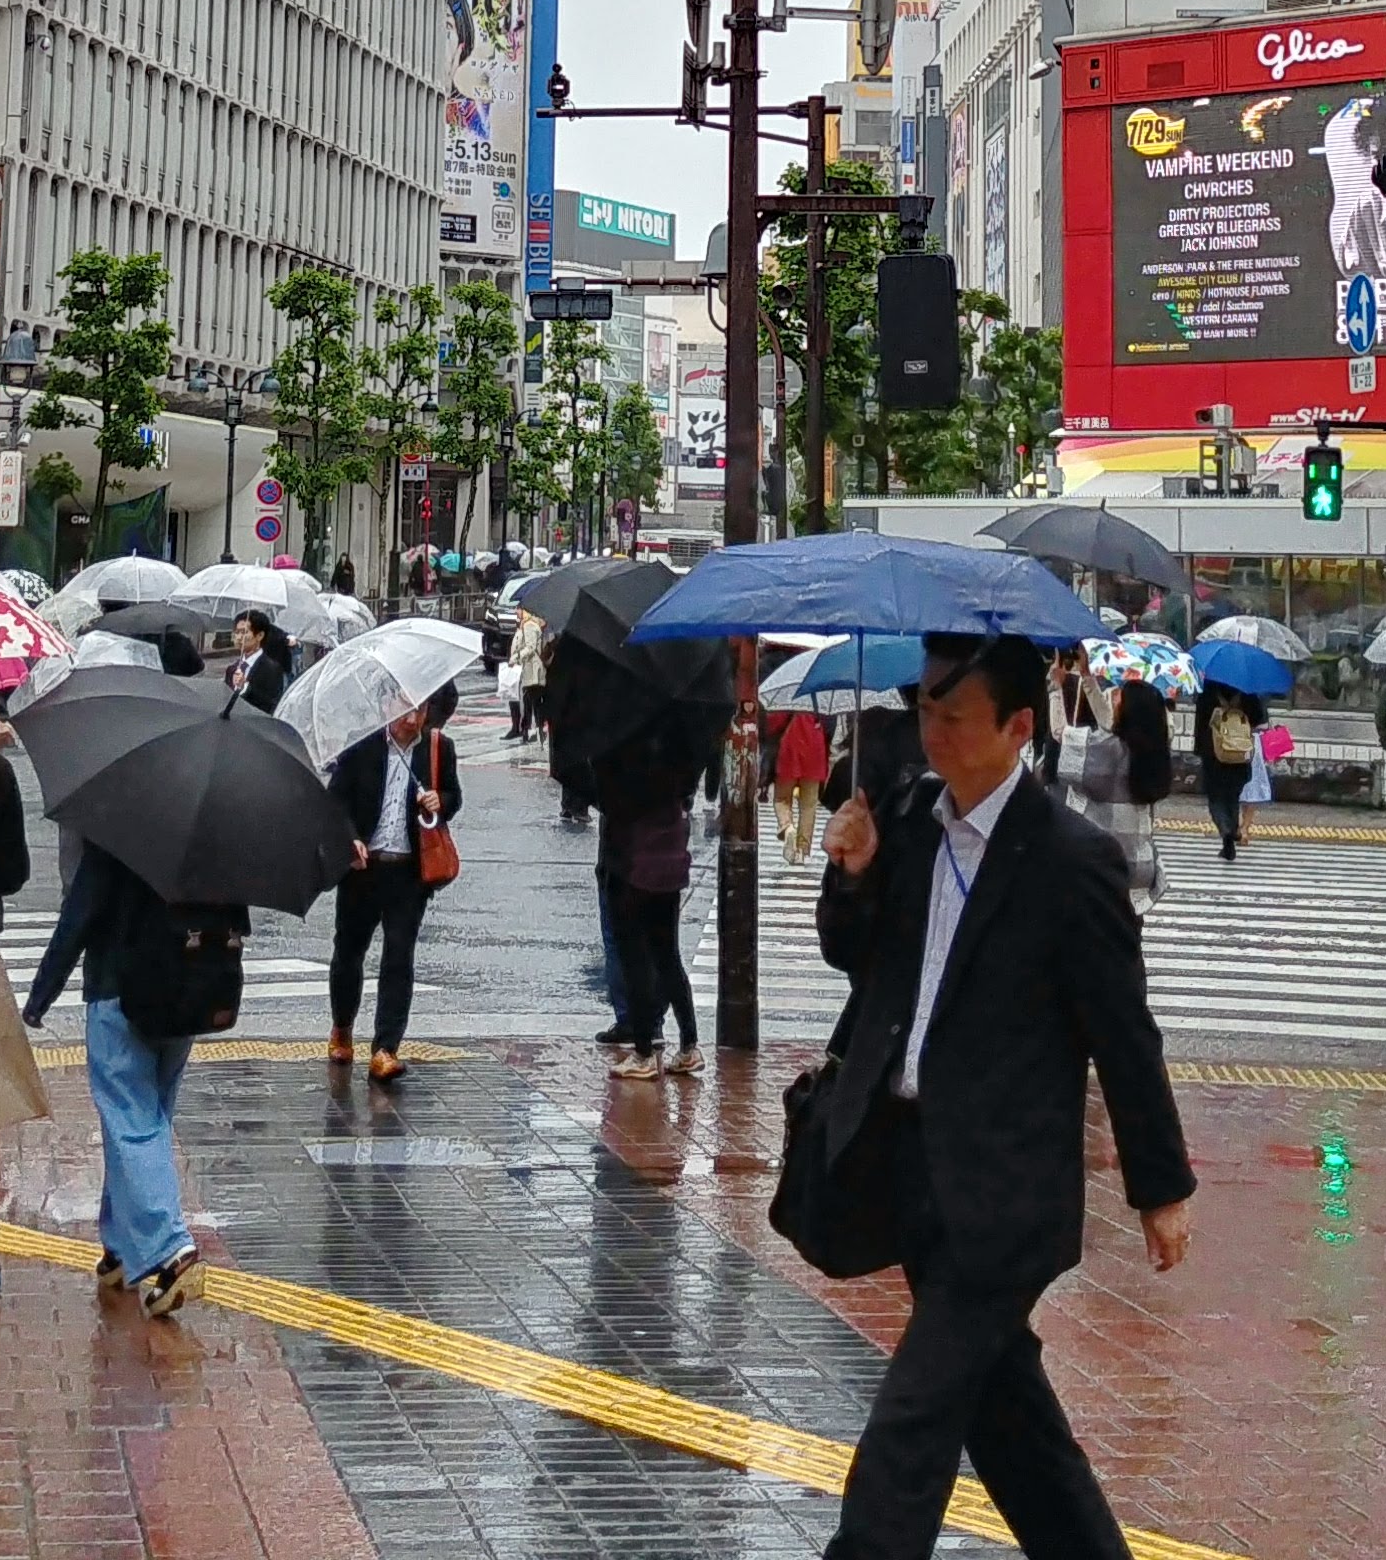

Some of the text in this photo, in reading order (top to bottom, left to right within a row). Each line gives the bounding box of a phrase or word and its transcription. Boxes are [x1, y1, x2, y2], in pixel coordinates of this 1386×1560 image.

[1258, 32, 1364, 79] Glico
[1128, 119, 1165, 146] 7/29
[1145, 149, 1294, 178] VAMPIRE WEEKEND
[1184, 179, 1254, 199] CHVRCHES
[582, 198, 670, 240] ニトリ NITORI
[1169, 203, 1271, 222] DIRTY PROJECTORS
[529, 193, 552, 275] SEIBU
[1159, 218, 1282, 238] GREENSKY BLUEGRASS
[1180, 235, 1259, 252] JACK JOHNSON
[1217, 260, 1232, 270] THE
[1233, 259, 1254, 270] FREE
[1255, 256, 1300, 269] NATIONALS
